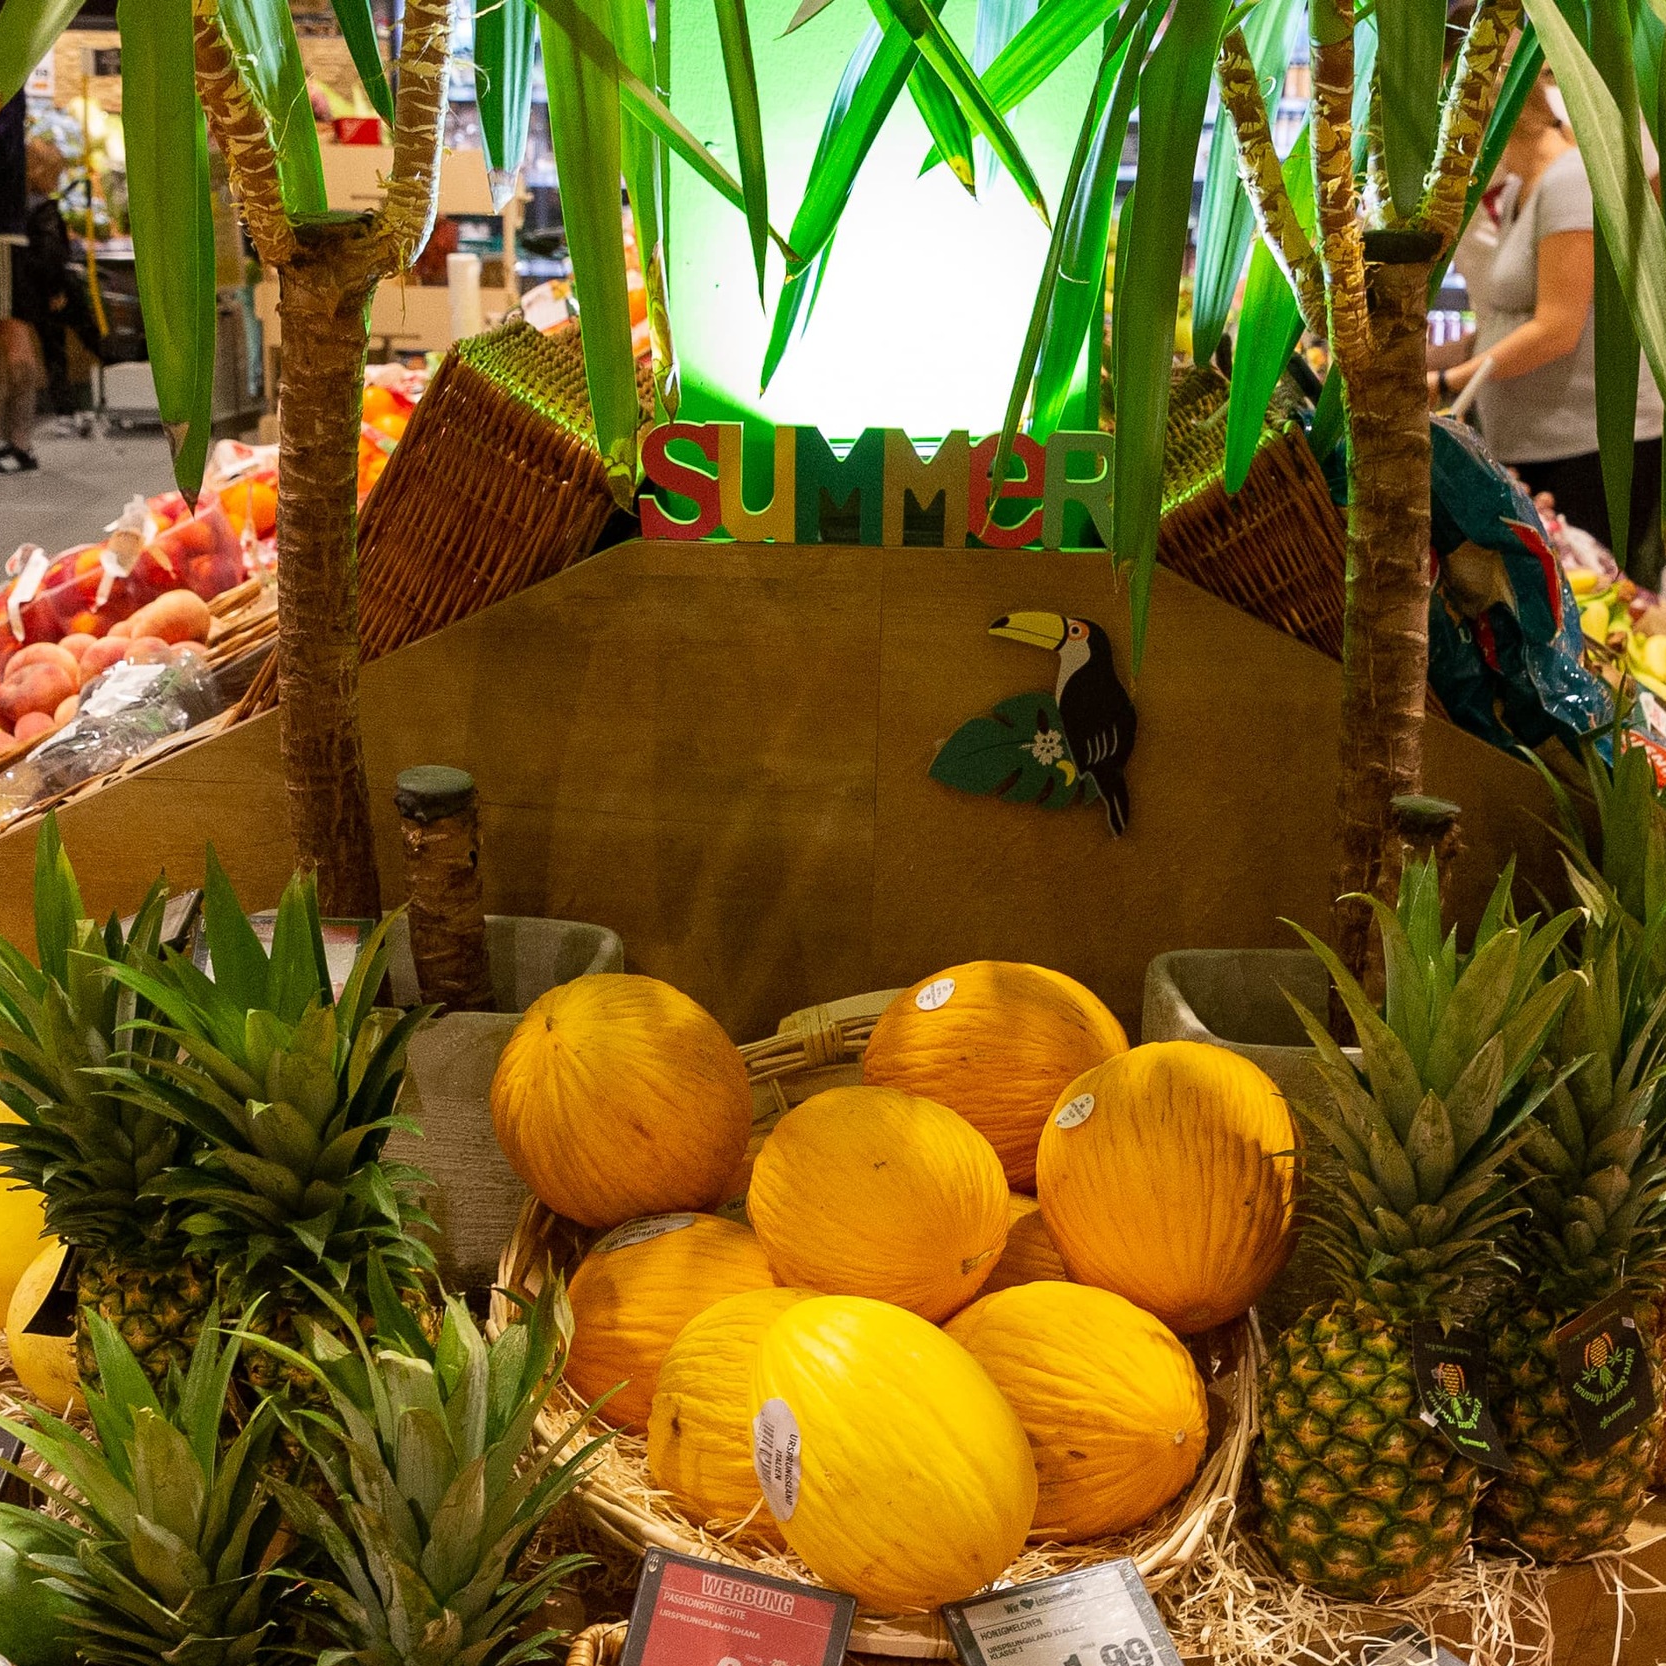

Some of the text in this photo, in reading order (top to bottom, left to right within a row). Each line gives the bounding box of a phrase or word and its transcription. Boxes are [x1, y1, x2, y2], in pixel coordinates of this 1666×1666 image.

[774, 1449, 783, 1481] ITALIEN
[784, 1433, 798, 1506] URSPRUNGSLAND
[663, 1591, 747, 1621] PASSIONSFRUECHTE
[701, 1574, 795, 1616] WERBUNG
[731, 1624, 761, 1640] GHANA
